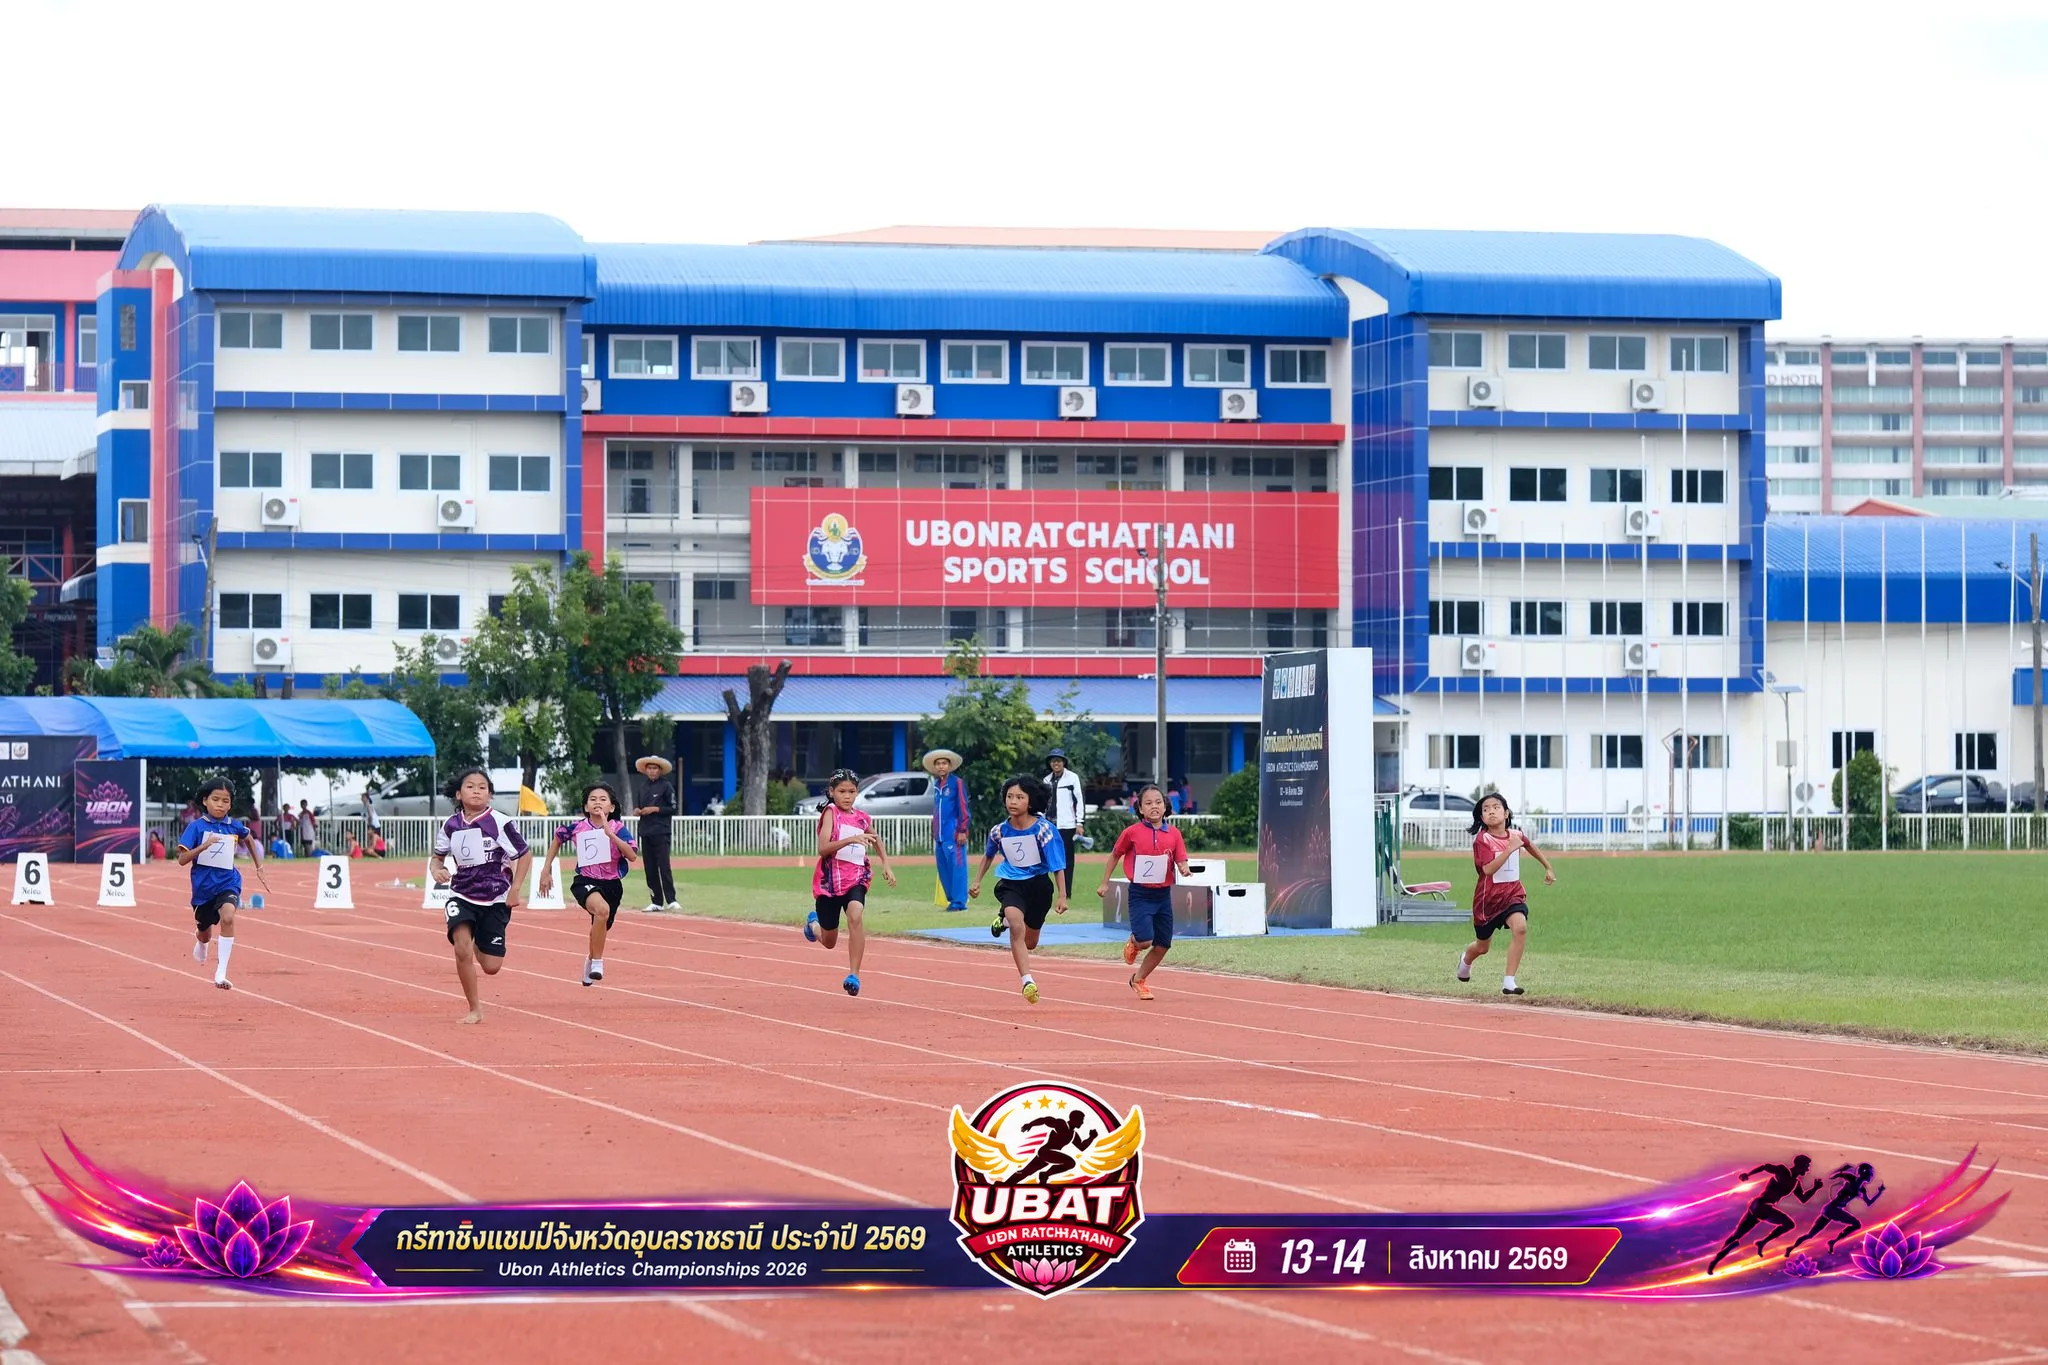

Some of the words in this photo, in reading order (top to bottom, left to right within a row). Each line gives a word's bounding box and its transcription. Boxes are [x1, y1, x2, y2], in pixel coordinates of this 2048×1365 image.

[1781, 375, 1821, 385] HOTEL
[906, 520, 1235, 549] UBONRATCHATHANI
[943, 556, 1067, 584] SPORTS
[1085, 557, 1210, 585] SCHOOL
[85, 801, 133, 813] UBON
[210, 841, 225, 859] 7
[461, 834, 471, 858] 6
[584, 837, 598, 860] 5
[1012, 841, 1026, 862] 3
[25, 860, 41, 885] 6
[109, 862, 125, 887] 5
[326, 864, 342, 889] 3
[1142, 860, 1154, 878] 2
[446, 901, 460, 917] 6
